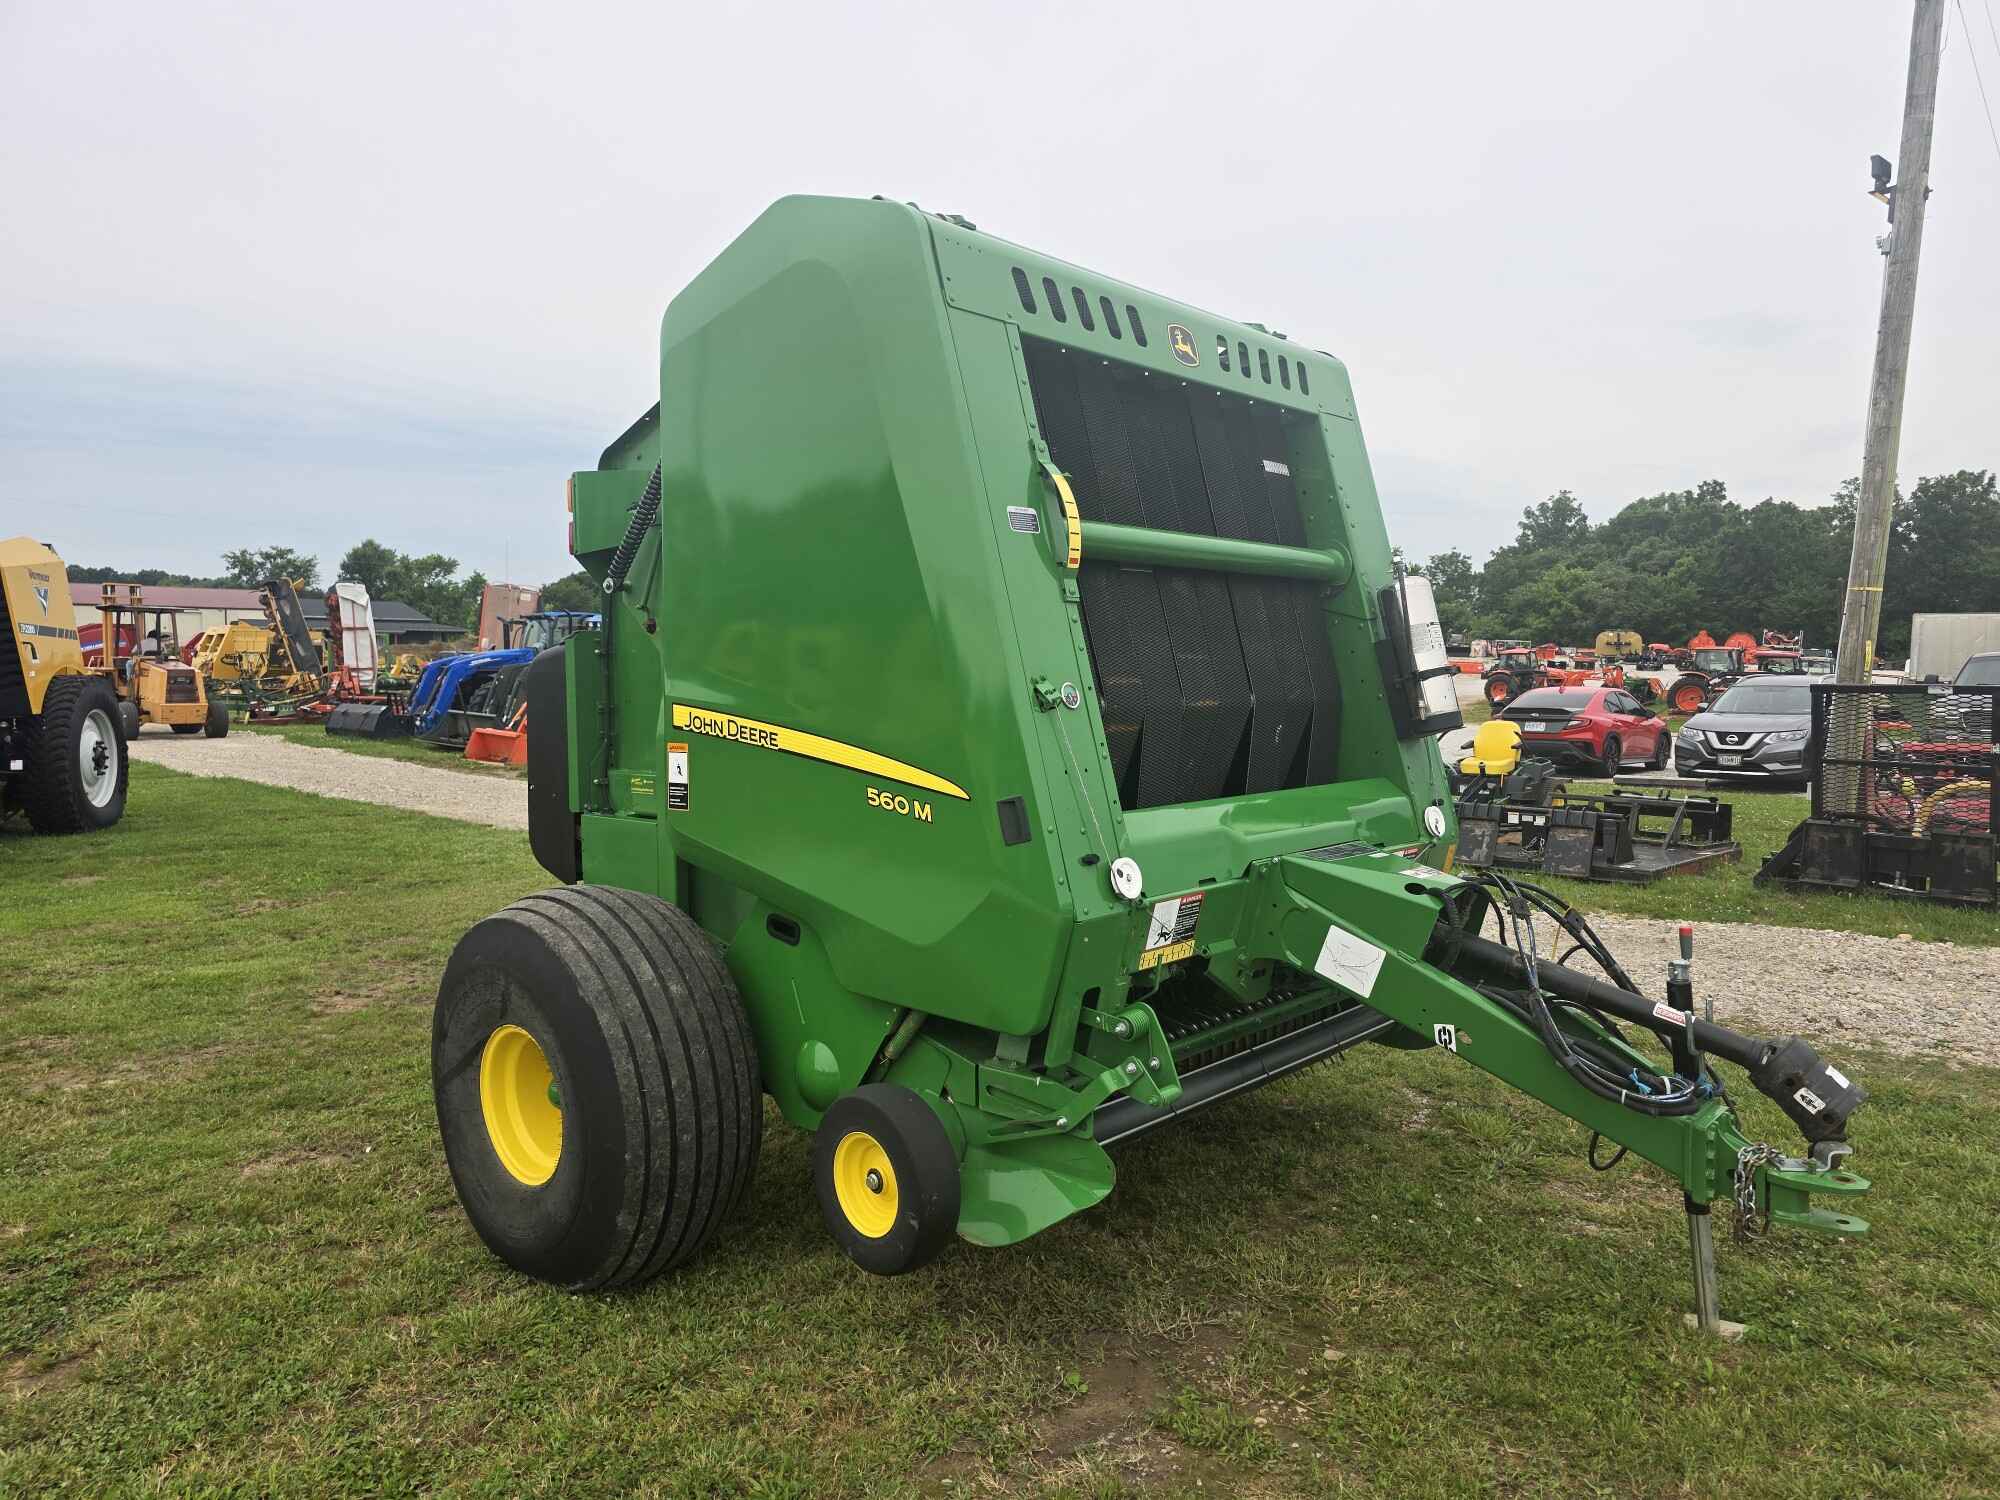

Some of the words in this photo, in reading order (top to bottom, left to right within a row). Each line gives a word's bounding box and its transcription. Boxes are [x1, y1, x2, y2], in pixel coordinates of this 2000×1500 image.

[684, 711, 724, 738] JOHN
[727, 718, 779, 748] DEERE
[866, 785, 910, 815] 560
[913, 799, 933, 824] M
